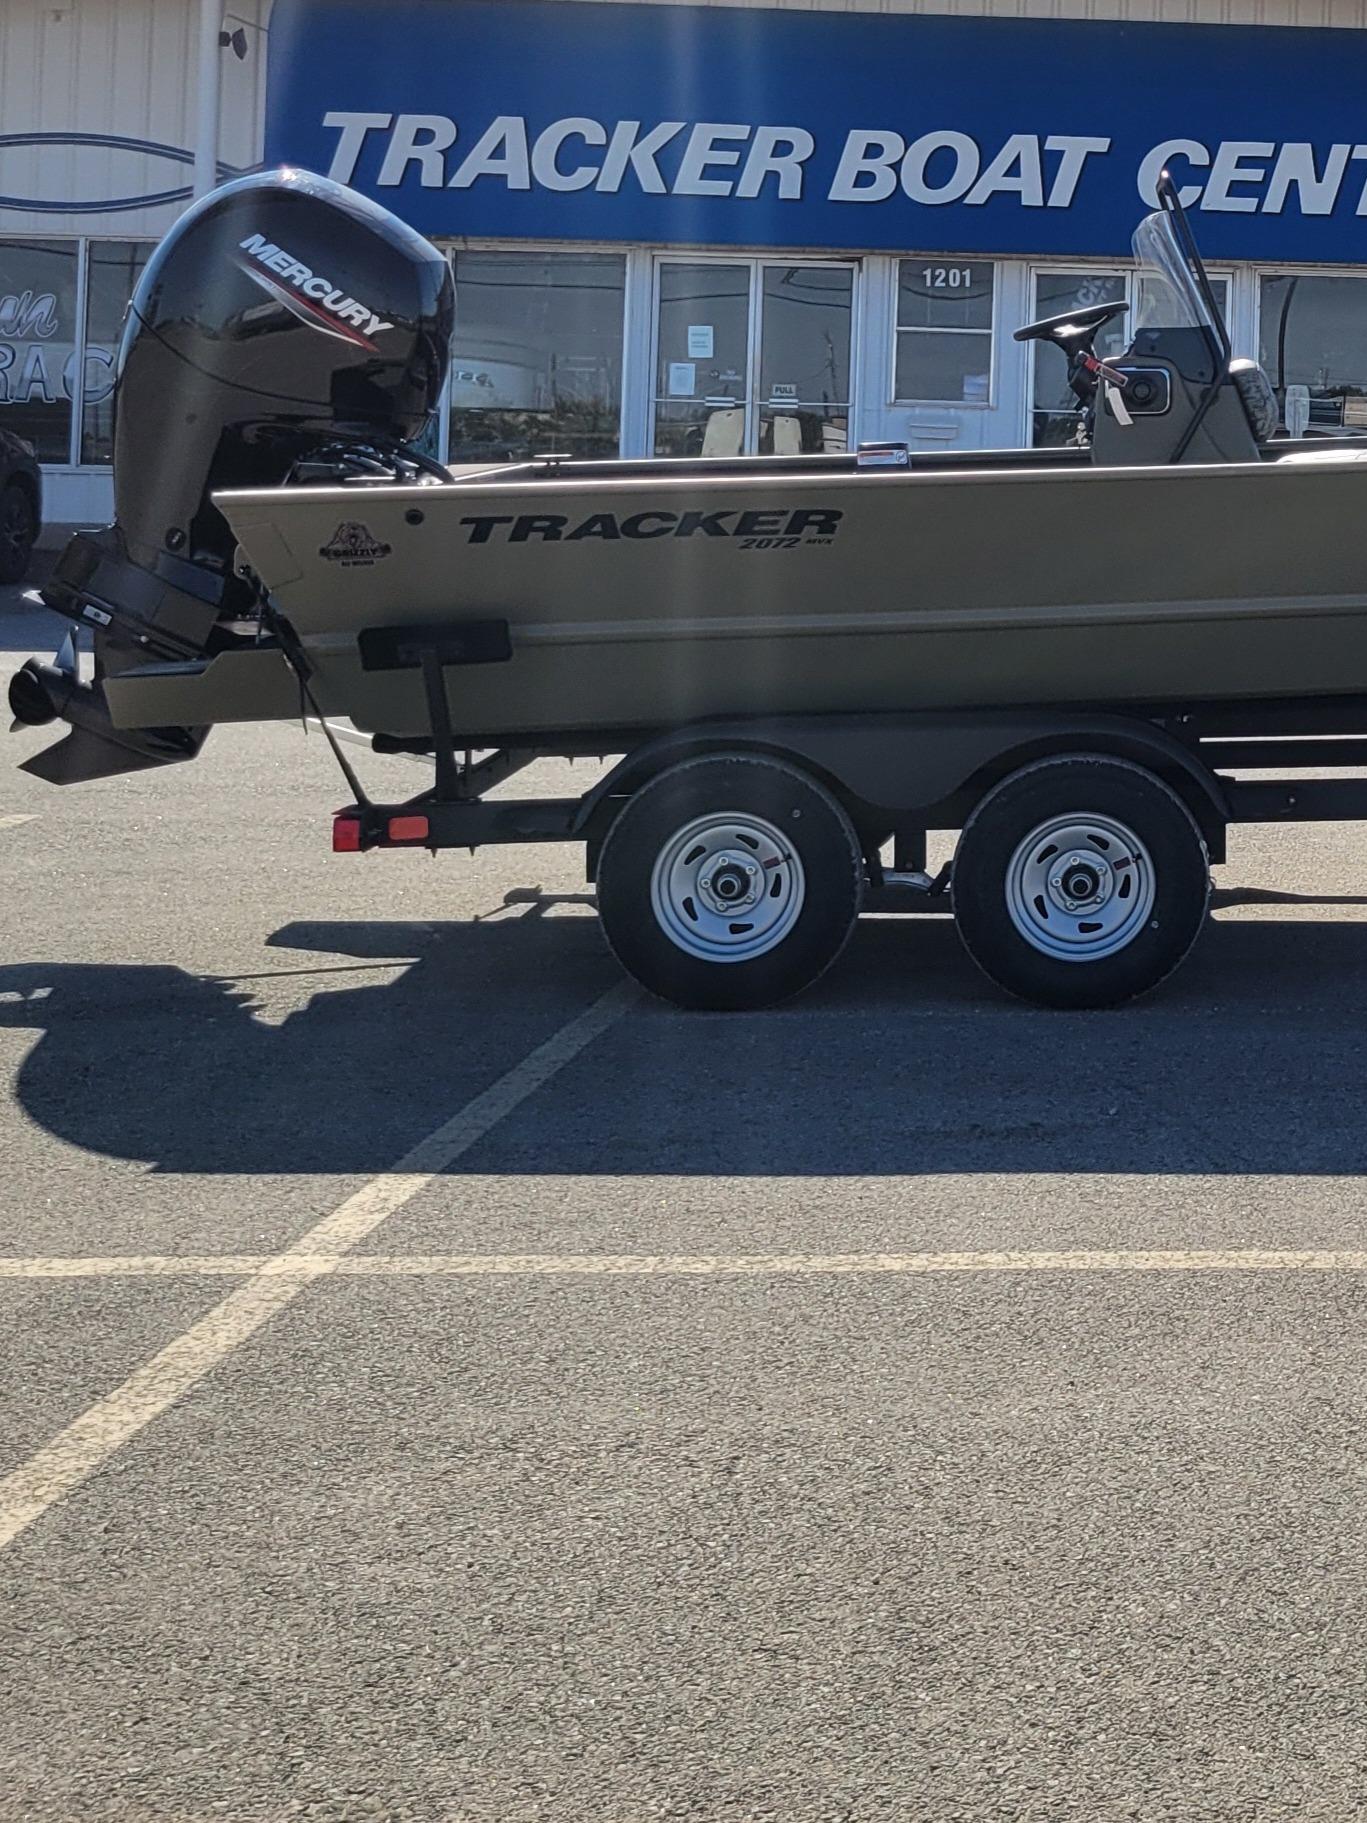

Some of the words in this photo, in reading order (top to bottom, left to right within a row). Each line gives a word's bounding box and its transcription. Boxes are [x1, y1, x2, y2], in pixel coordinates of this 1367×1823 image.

[322, 111, 815, 200] TRACKER
[827, 129, 1112, 208] BOAT
[239, 233, 395, 336] MERCURY
[922, 268, 971, 288] 1201
[774, 386, 795, 394] PULL
[459, 509, 843, 543] TRACKER
[738, 536, 801, 549] 2072
